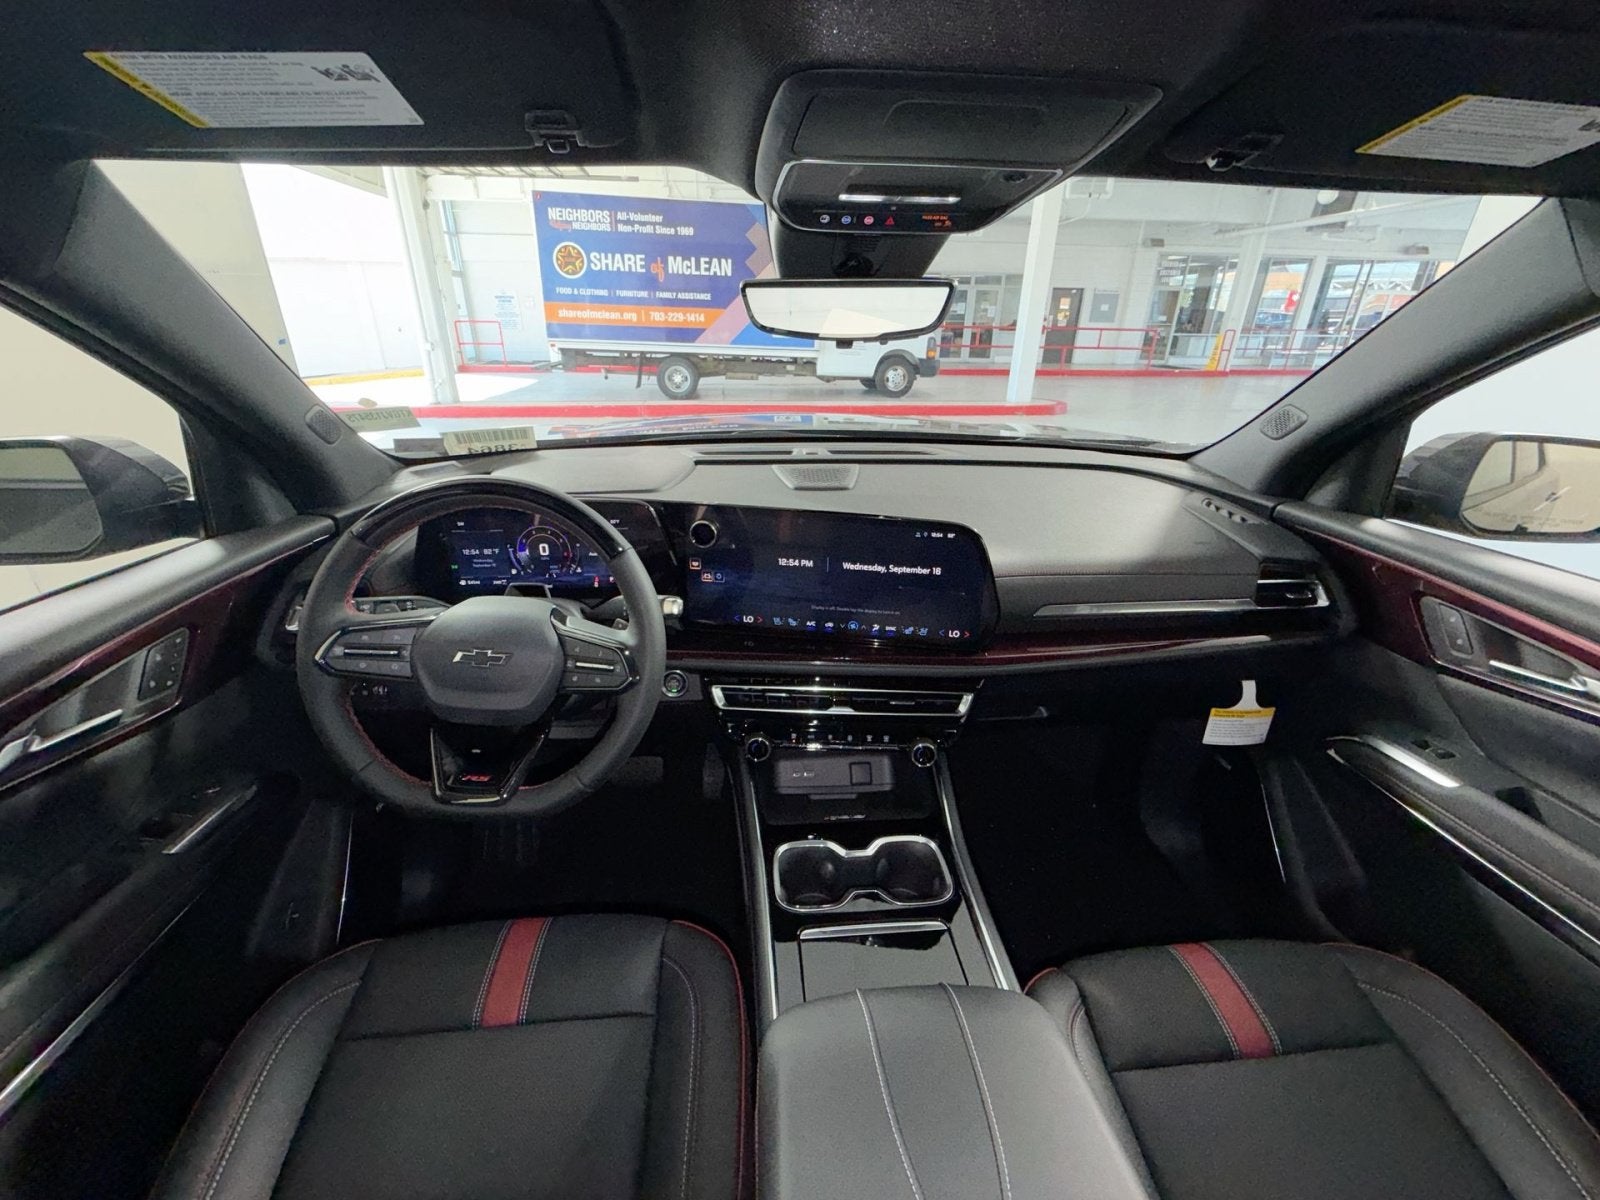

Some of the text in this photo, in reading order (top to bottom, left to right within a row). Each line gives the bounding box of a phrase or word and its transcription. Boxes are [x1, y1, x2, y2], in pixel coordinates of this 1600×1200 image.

[548, 207, 610, 223] NEIGHBORS
[617, 212, 663, 223] All-Volunteer
[572, 221, 611, 232] NEIGHBORS
[617, 224, 694, 236] Non-Profit Since 1969
[590, 252, 645, 273] SHARE
[668, 256, 732, 276] McLEAN
[650, 256, 665, 282] of
[555, 287, 572, 295] FOOD
[579, 288, 608, 297] CLOTHING
[616, 290, 649, 298] FURNITURE
[655, 291, 712, 301] FAMILY ASSISTANCE
[558, 307, 636, 322] shareofmclean.org
[649, 311, 705, 323] 703-229-1414
[538, 543, 549, 556] 0
[778, 558, 814, 568] 12:54 PM
[842, 562, 887, 573] Wednesday,
[888, 564, 931, 575] September
[742, 615, 754, 624] LO
[948, 630, 960, 639] LO
